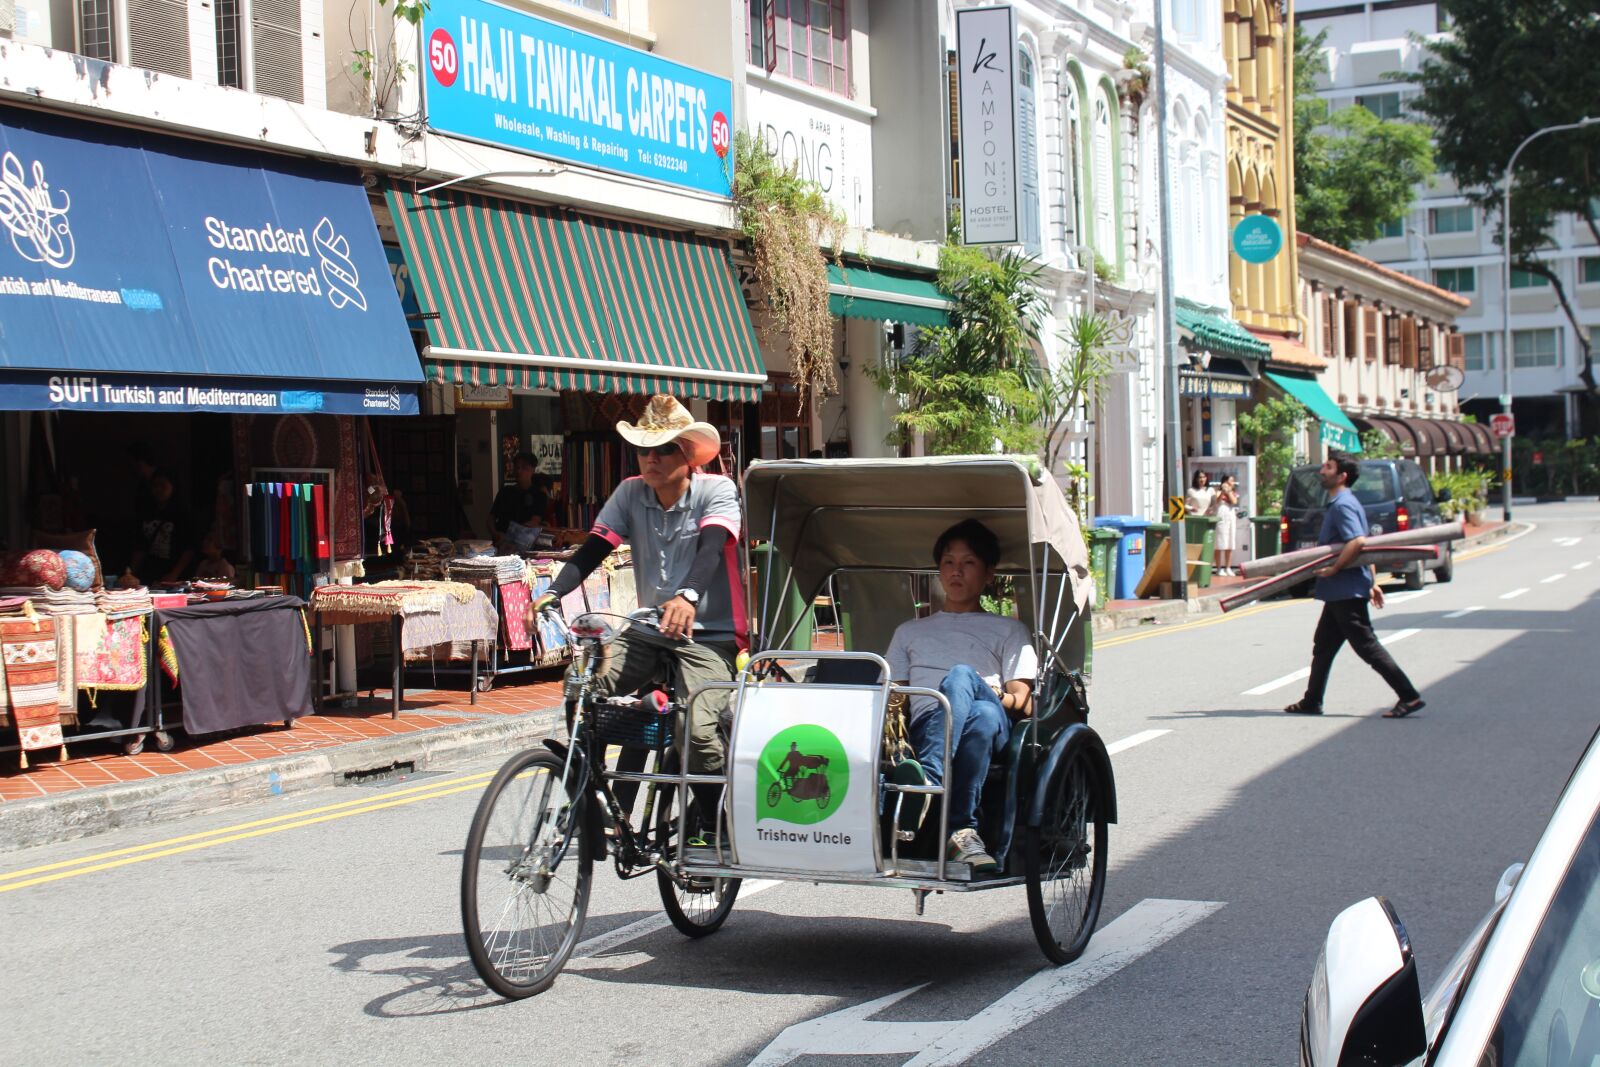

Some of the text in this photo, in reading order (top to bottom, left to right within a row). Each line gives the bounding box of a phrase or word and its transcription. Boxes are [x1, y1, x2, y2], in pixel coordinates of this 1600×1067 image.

[431, 40, 457, 74] 50
[460, 16, 708, 154] HAJI TAWAKAL CARPETS
[712, 120, 730, 148] 50
[815, 120, 831, 135] ARAB
[494, 113, 688, 173] Wholesale, Washing & Repairing Tel: 62922340
[969, 205, 1009, 215] HOSTEL
[204, 216, 310, 257] Standard
[30, 278, 53, 297] and
[50, 278, 122, 304] Mediterranean
[207, 257, 322, 297] Chartered
[48, 376, 98, 403] SUFI
[101, 384, 155, 404] Turkish
[158, 387, 184, 404] and
[187, 387, 277, 408] Mediterranean
[363, 398, 390, 408] Chartered
[365, 388, 389, 398] Standard
[756, 828, 852, 845] Trishaw Uncle
